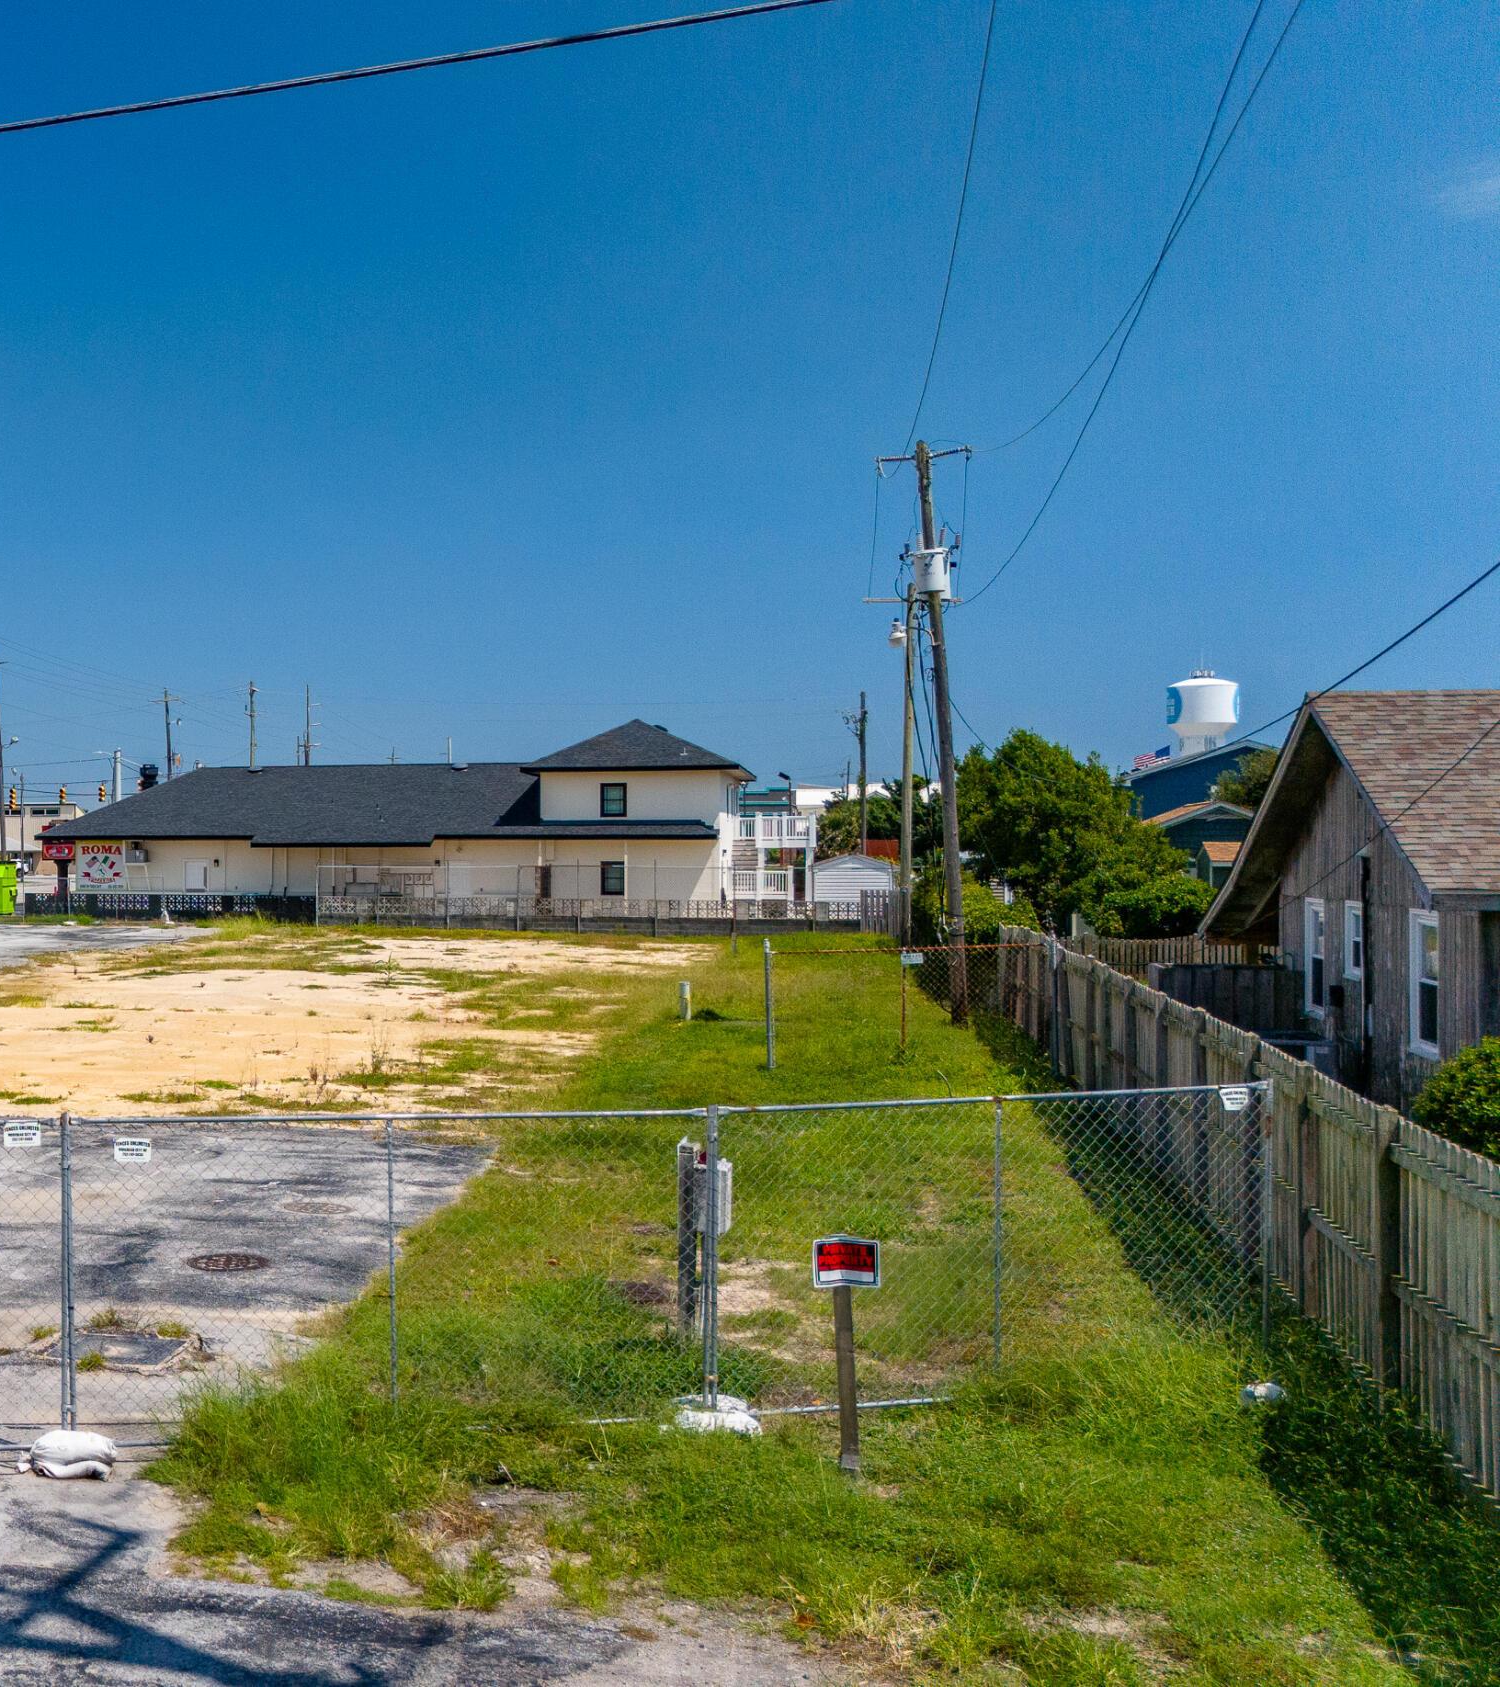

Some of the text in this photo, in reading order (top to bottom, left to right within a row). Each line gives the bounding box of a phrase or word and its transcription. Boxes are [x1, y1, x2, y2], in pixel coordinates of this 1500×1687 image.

[80, 844, 122, 855] ROMA
[822, 1243, 868, 1255] PRIVATE
[818, 1254, 873, 1265] PROPERTY
